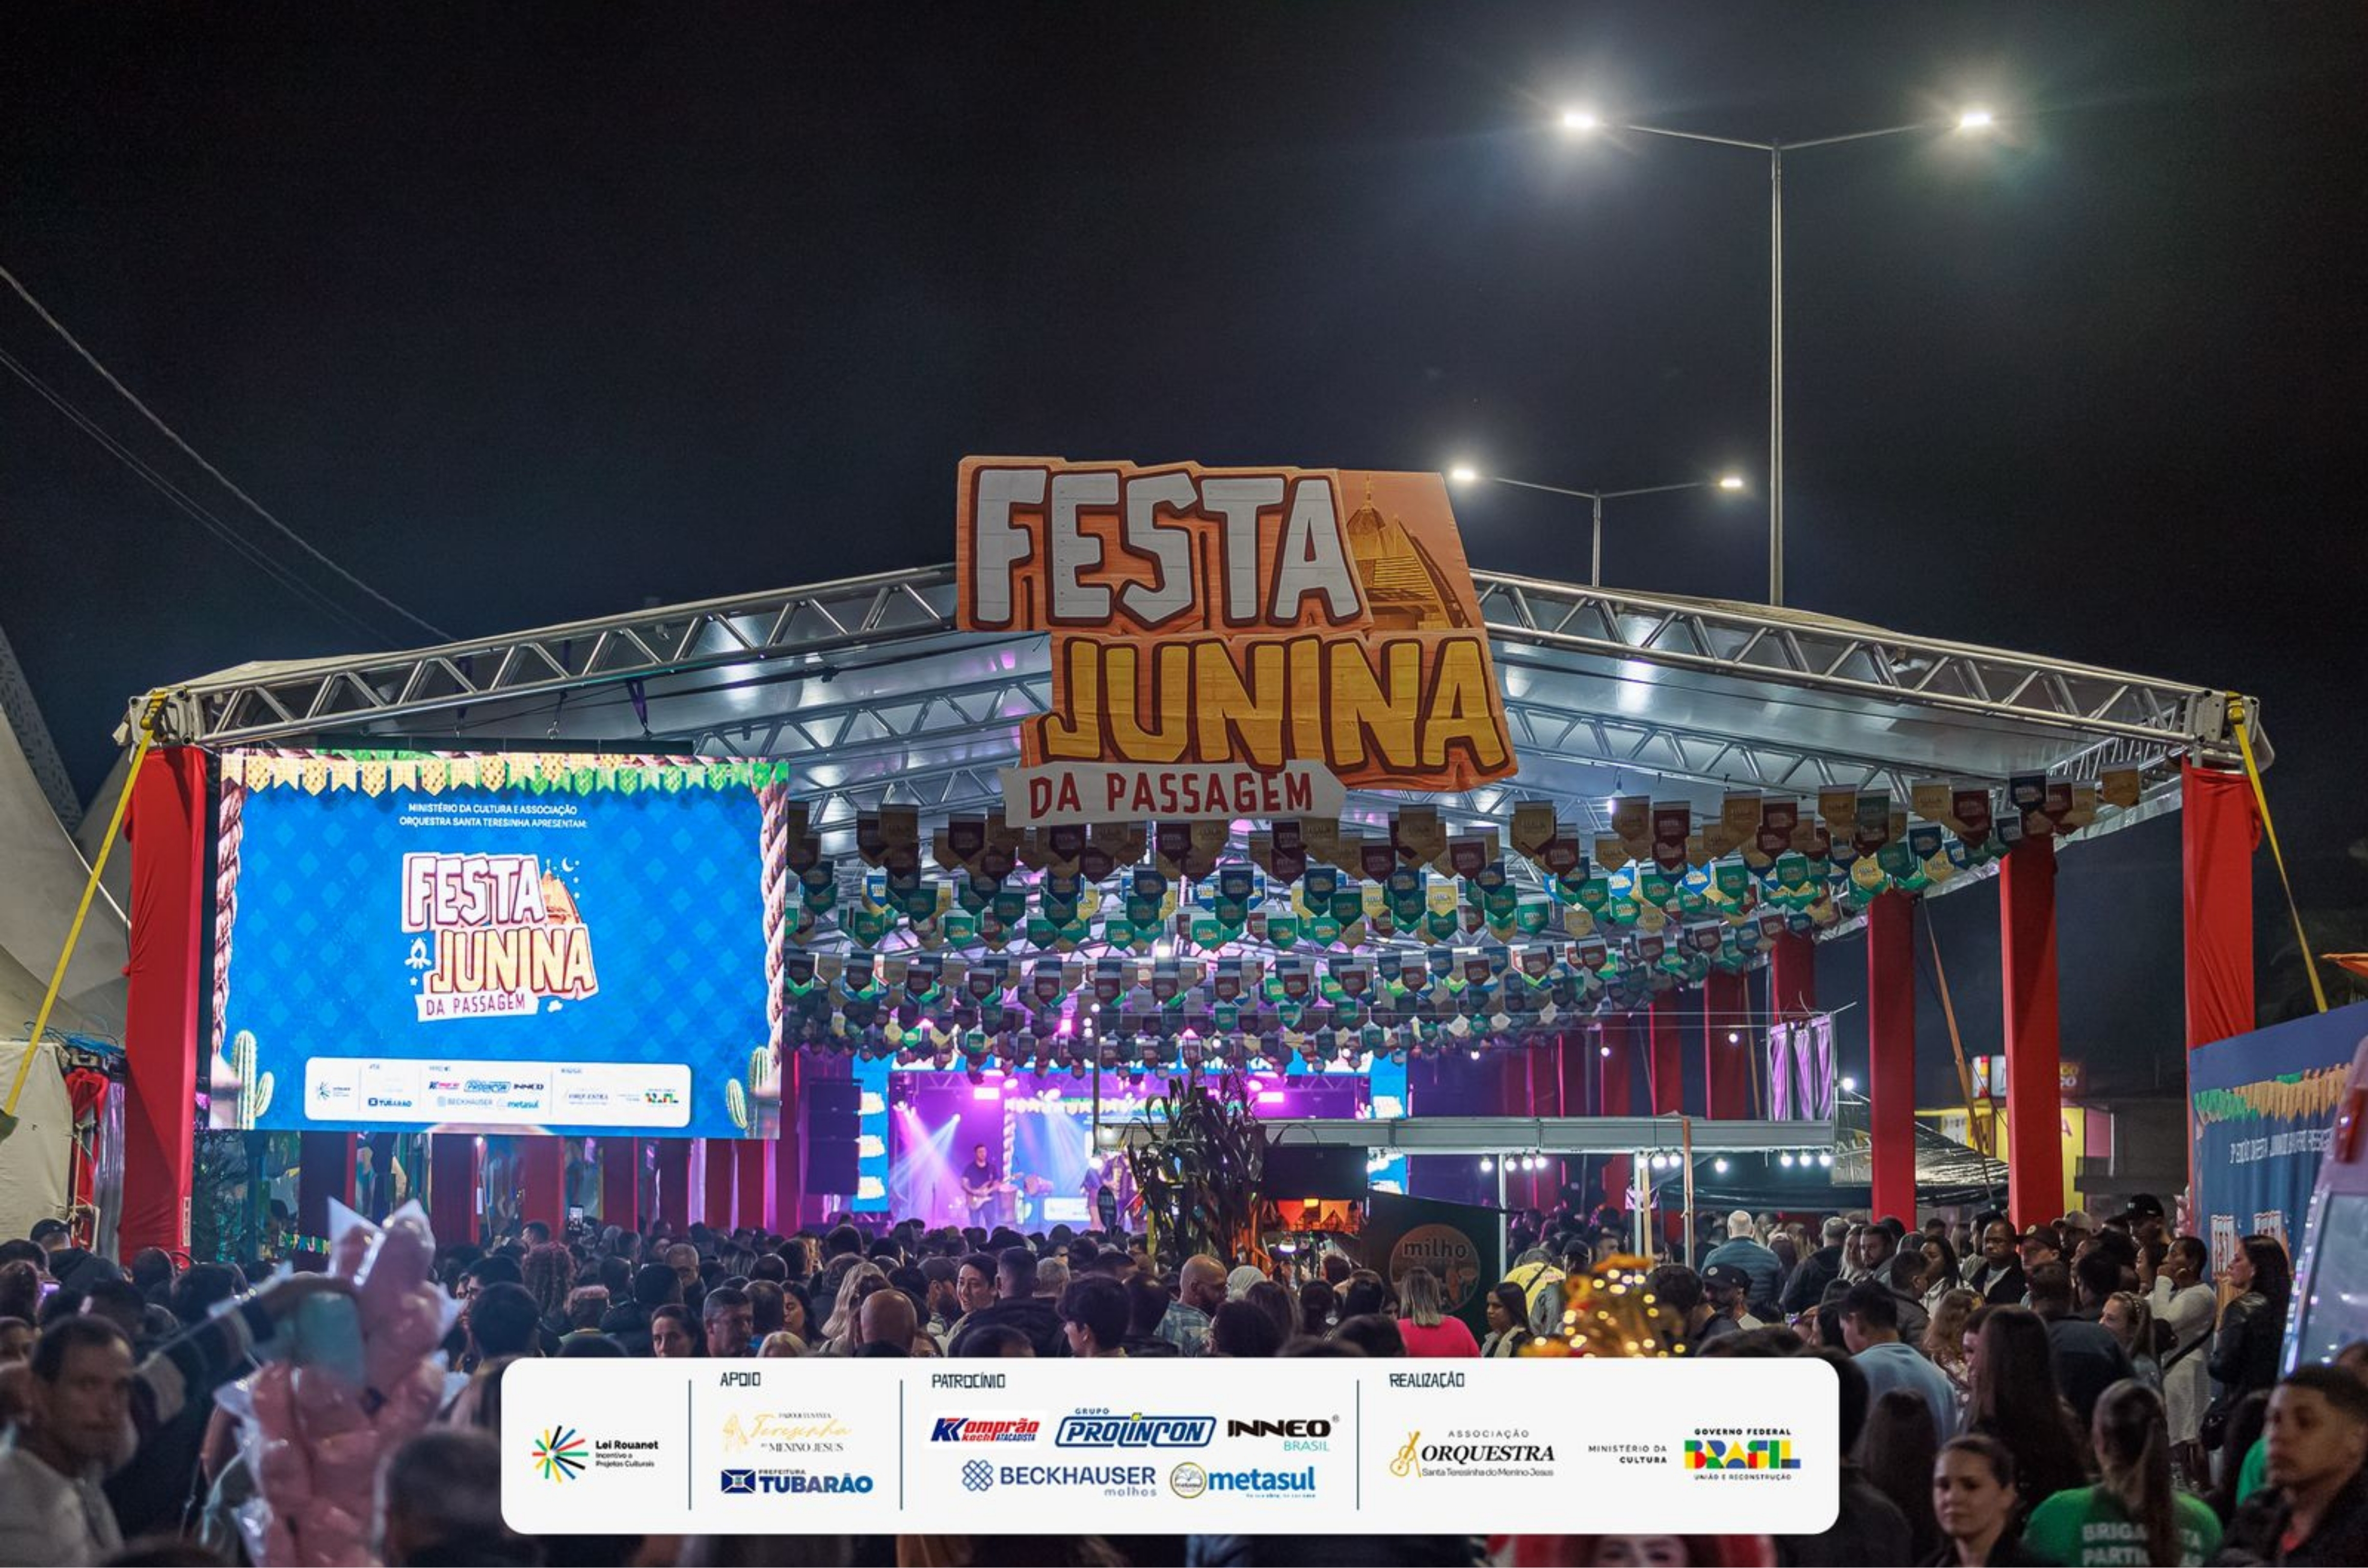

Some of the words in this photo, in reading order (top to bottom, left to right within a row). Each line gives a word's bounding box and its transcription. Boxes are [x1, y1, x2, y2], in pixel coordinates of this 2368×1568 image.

[972, 465, 1363, 629] FESTA
[1041, 636, 1509, 774] JUNINA
[408, 802, 457, 812] MINISTÉRIO
[460, 804, 472, 812] DA
[474, 804, 511, 813] CULTURA
[514, 805, 518, 813] E
[520, 804, 577, 817] ASSOCIAÇÃO
[1030, 775, 1081, 818] DA
[1107, 771, 1313, 813] PASSAGEM
[399, 816, 451, 827] ORQUESTRA
[453, 817, 481, 826] SANTA
[483, 818, 530, 827] TERESINHA
[409, 856, 545, 926] FESTA
[430, 927, 595, 994] JUNINA
[426, 999, 445, 1016] DA
[454, 994, 525, 1014] PASSAGEM
[1403, 1238, 1467, 1257] milho
